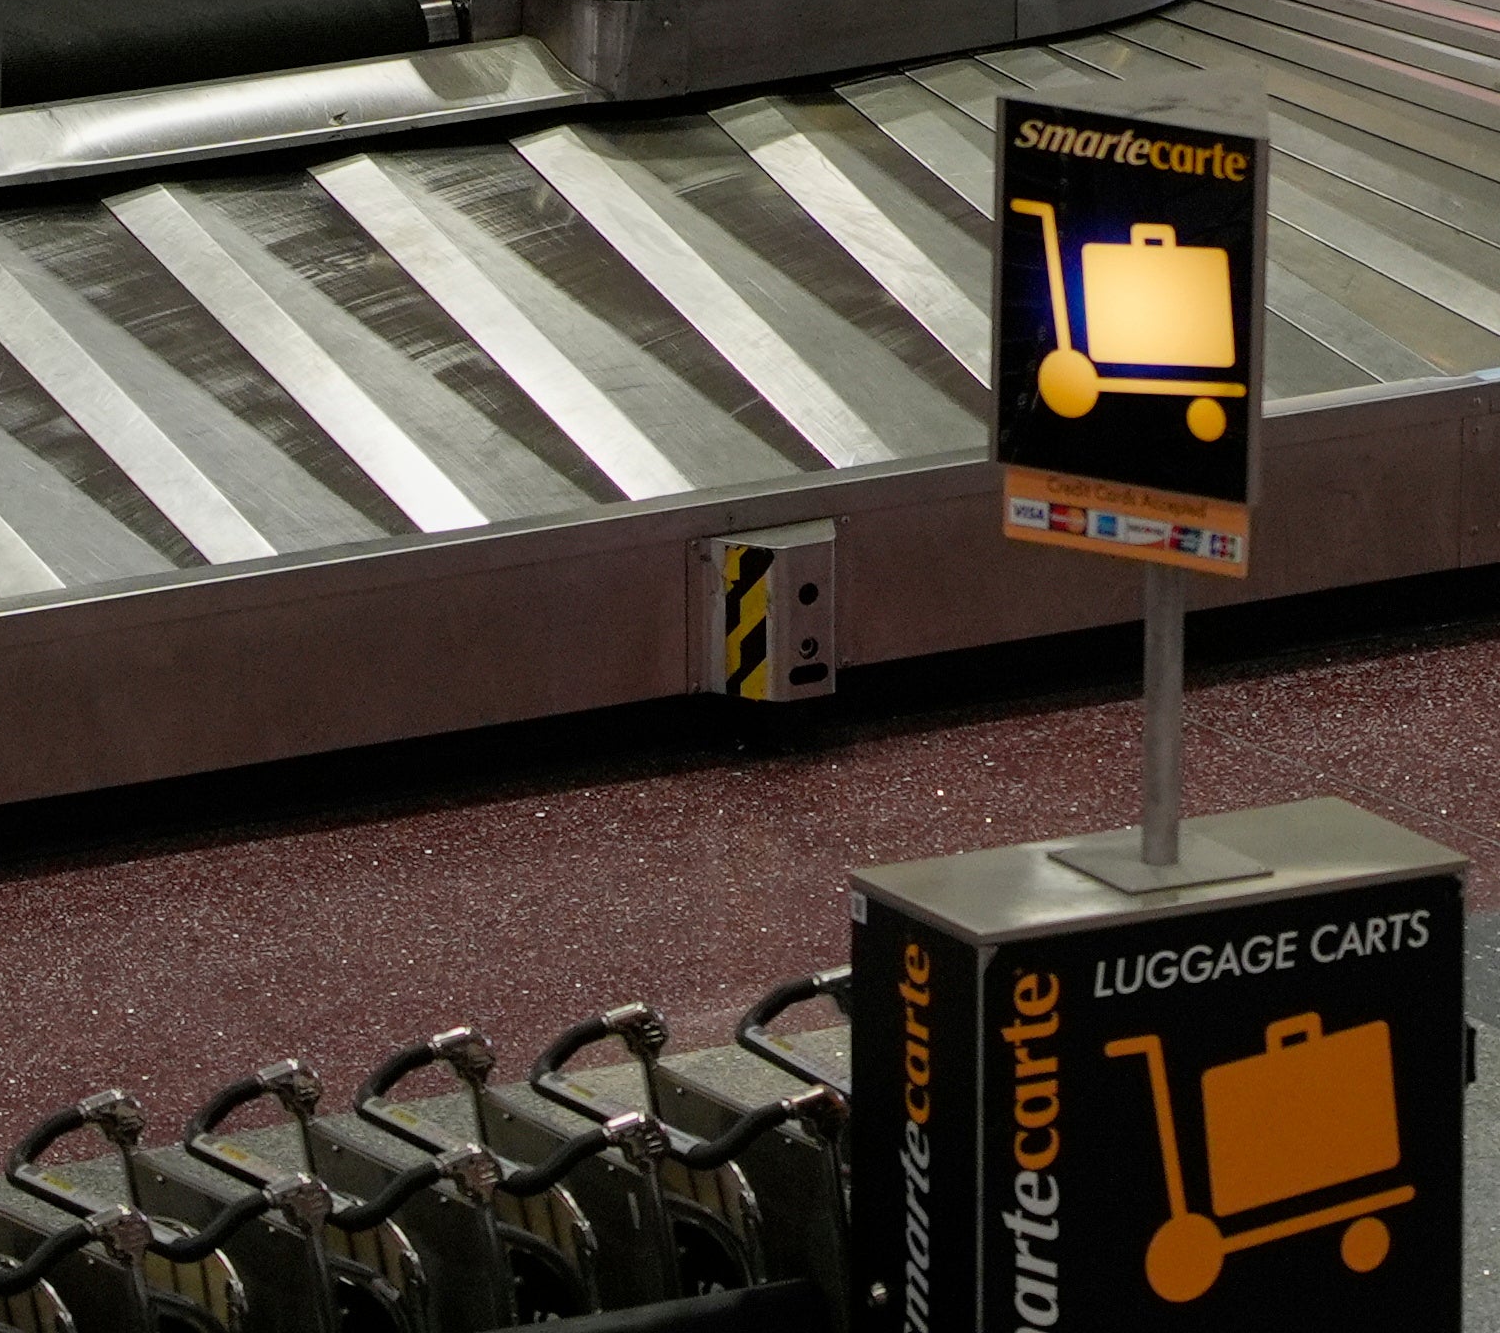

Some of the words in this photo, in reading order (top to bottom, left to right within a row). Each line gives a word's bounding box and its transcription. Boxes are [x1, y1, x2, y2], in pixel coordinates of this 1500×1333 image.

[1013, 118, 1248, 182] smartecarte
[1013, 504, 1045, 522] VISA
[1093, 931, 1298, 1000] LUGGAGE
[1309, 908, 1431, 963] CARTS
